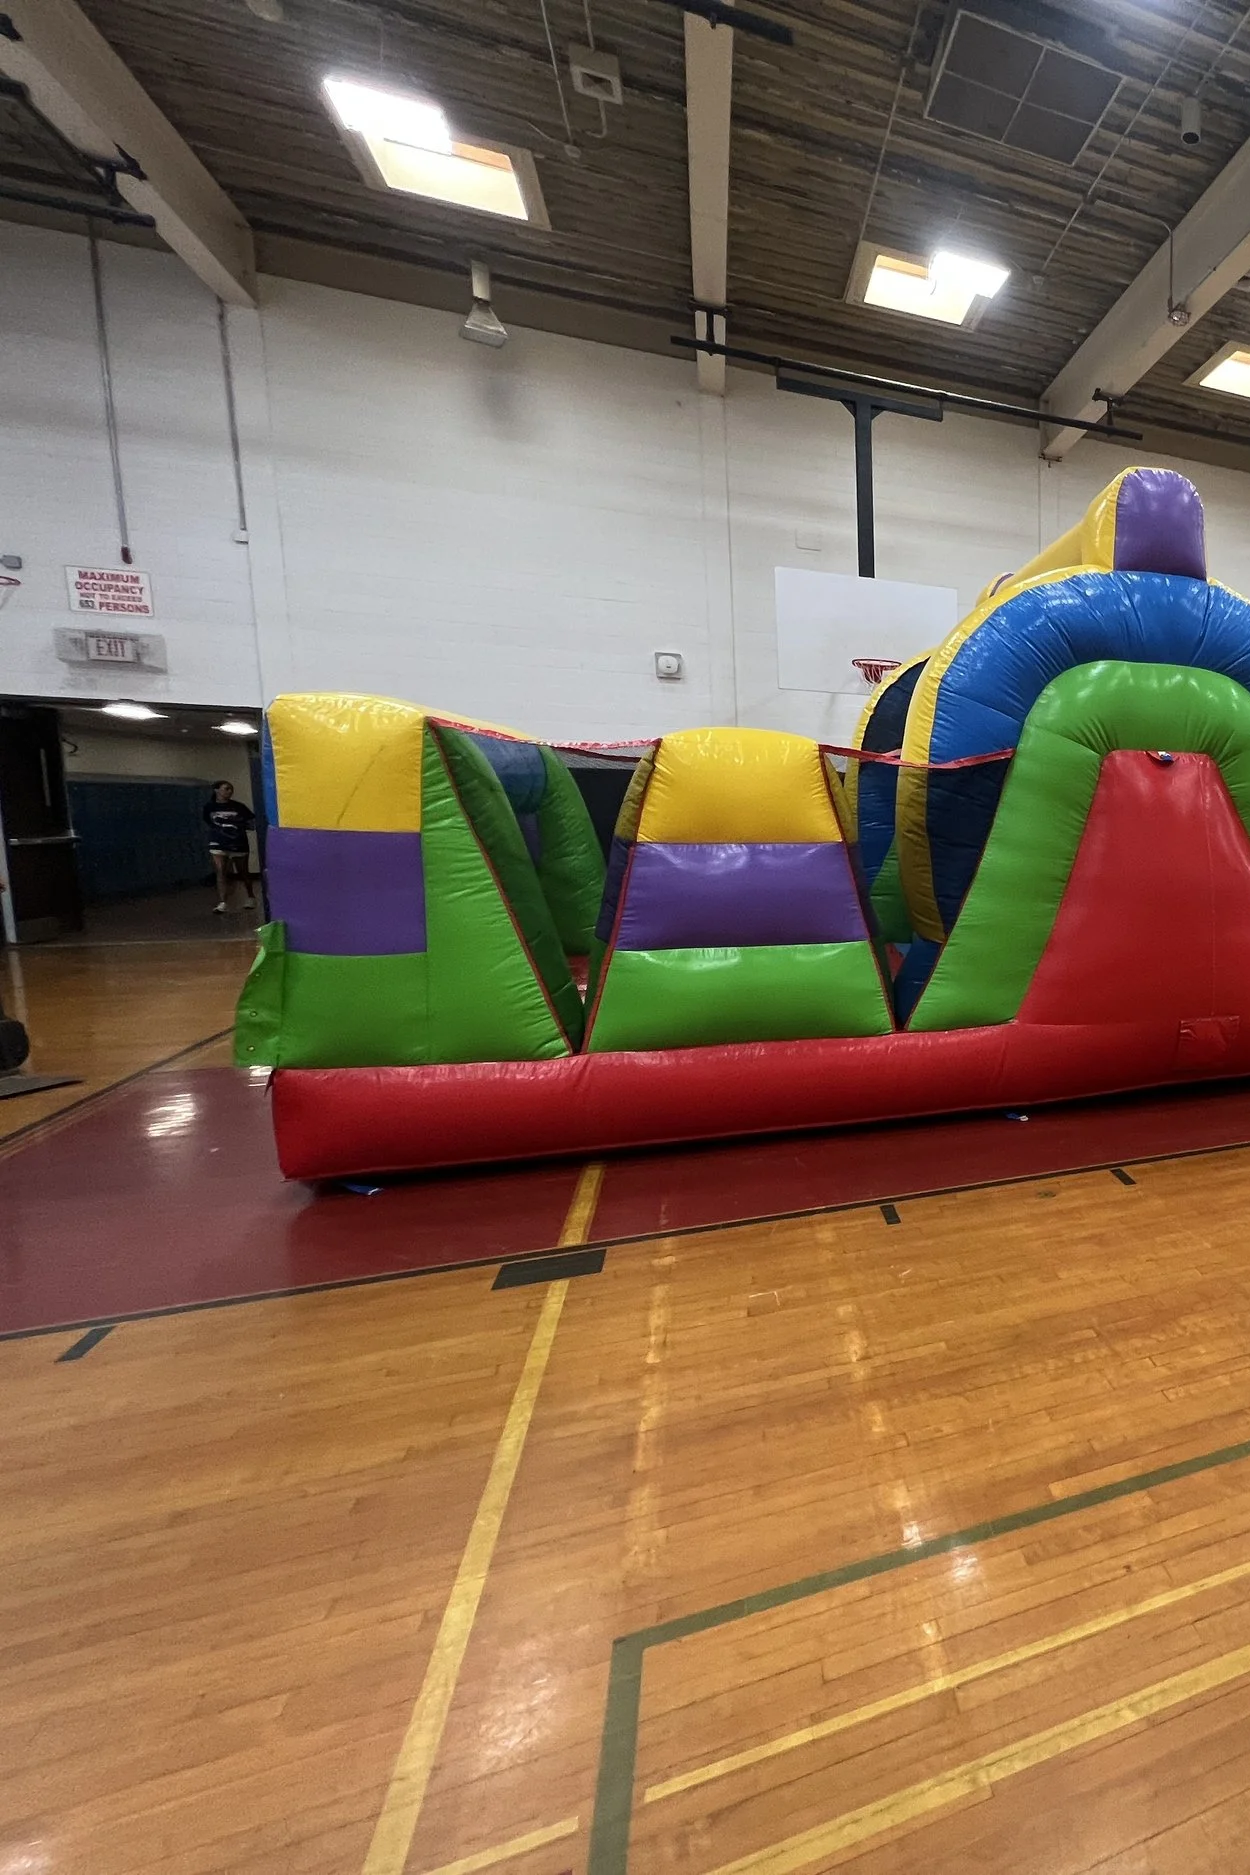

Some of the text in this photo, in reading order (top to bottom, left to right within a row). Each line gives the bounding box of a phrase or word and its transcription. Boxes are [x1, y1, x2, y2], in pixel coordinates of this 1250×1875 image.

[78, 571, 140, 584] MAXIMUM
[75, 581, 144, 594] OCCUPANCY
[99, 602, 149, 614] PERSONS
[96, 639, 126, 657] EXIT
